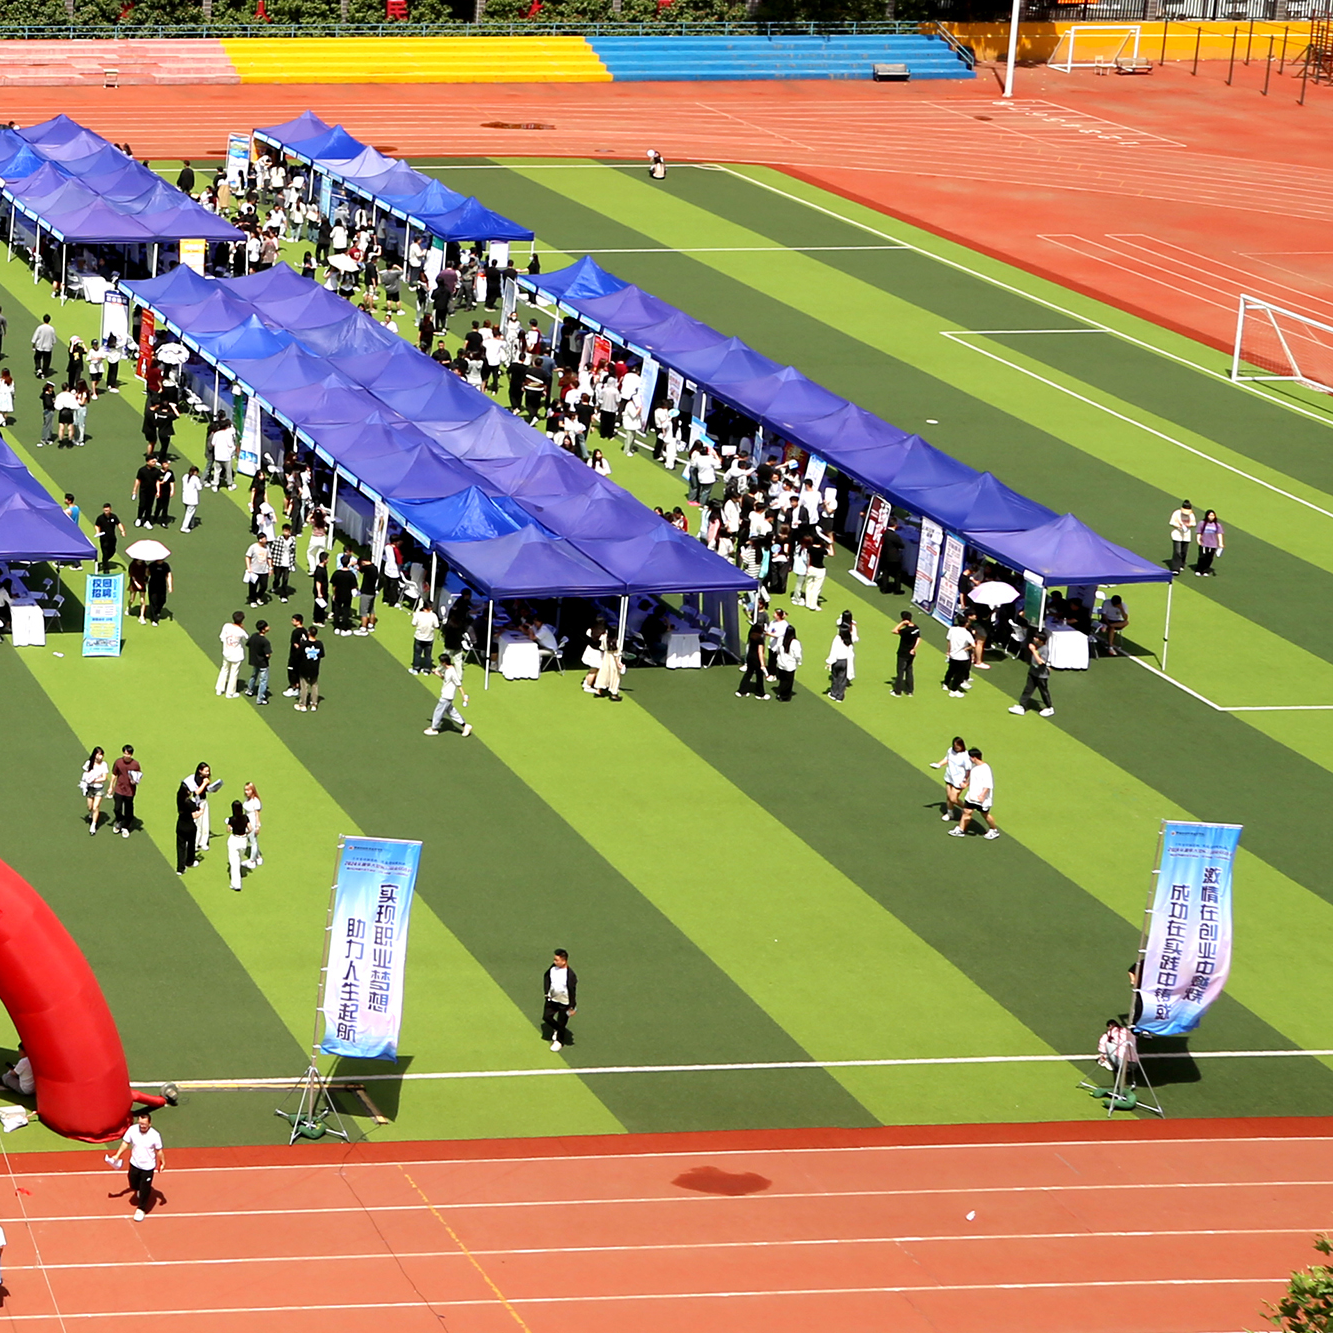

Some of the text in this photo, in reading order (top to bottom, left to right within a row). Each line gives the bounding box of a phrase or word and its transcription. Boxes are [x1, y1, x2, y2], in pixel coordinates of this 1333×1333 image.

[336, 917, 366, 1044] 助力人生起航
[367, 883, 399, 1014] 实现职业梦想
[1182, 866, 1222, 1006] 激情在创业中燃烧
